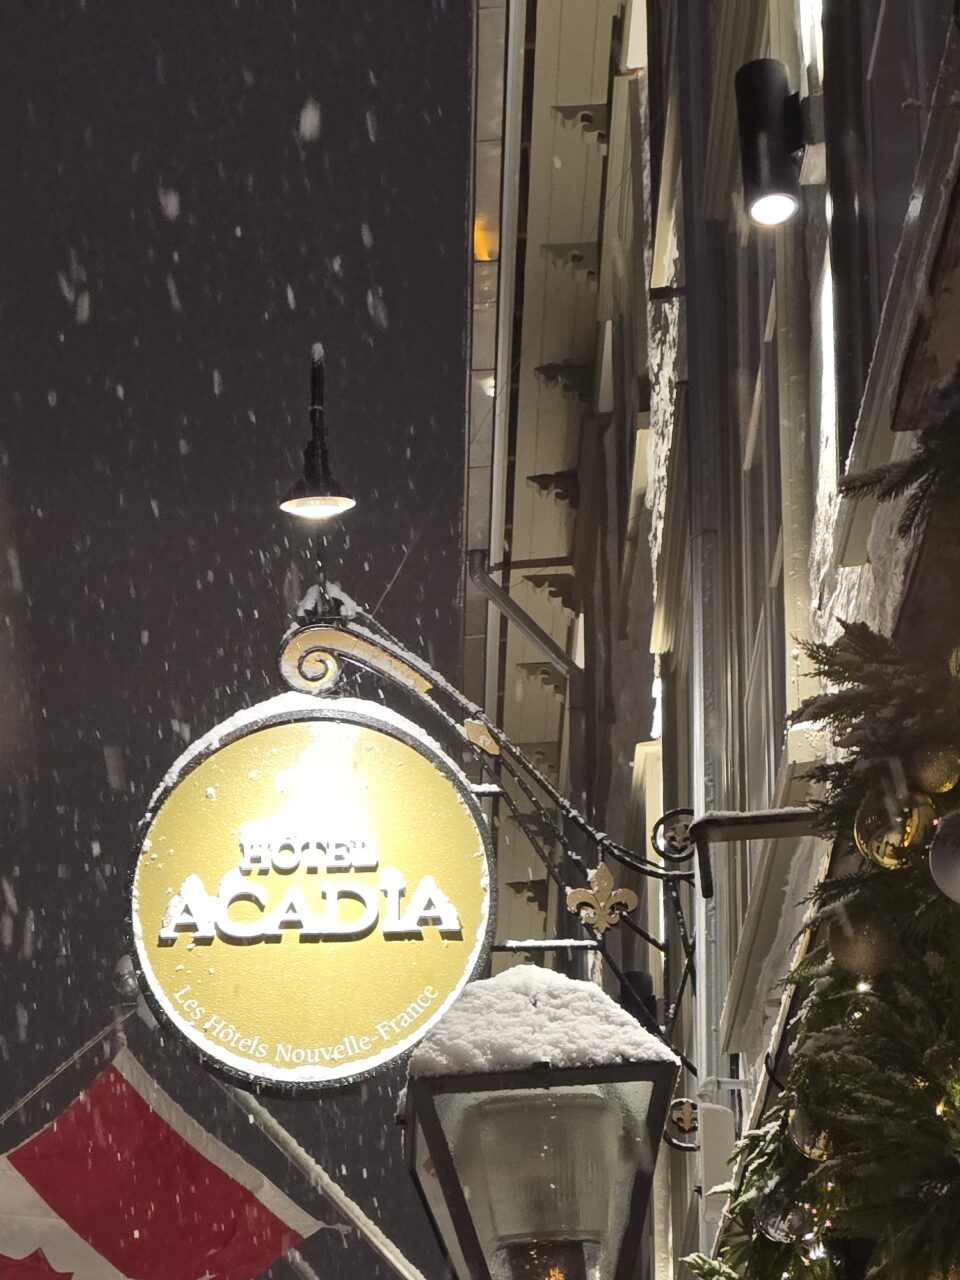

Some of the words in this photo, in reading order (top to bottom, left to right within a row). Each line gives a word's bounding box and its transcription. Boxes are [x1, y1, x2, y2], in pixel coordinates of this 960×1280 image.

[157, 874, 463, 947] ACADIA
[174, 984, 206, 1020] Les
[207, 1014, 268, 1058] Hôtels
[274, 984, 439, 1063] Nouvelle-France
